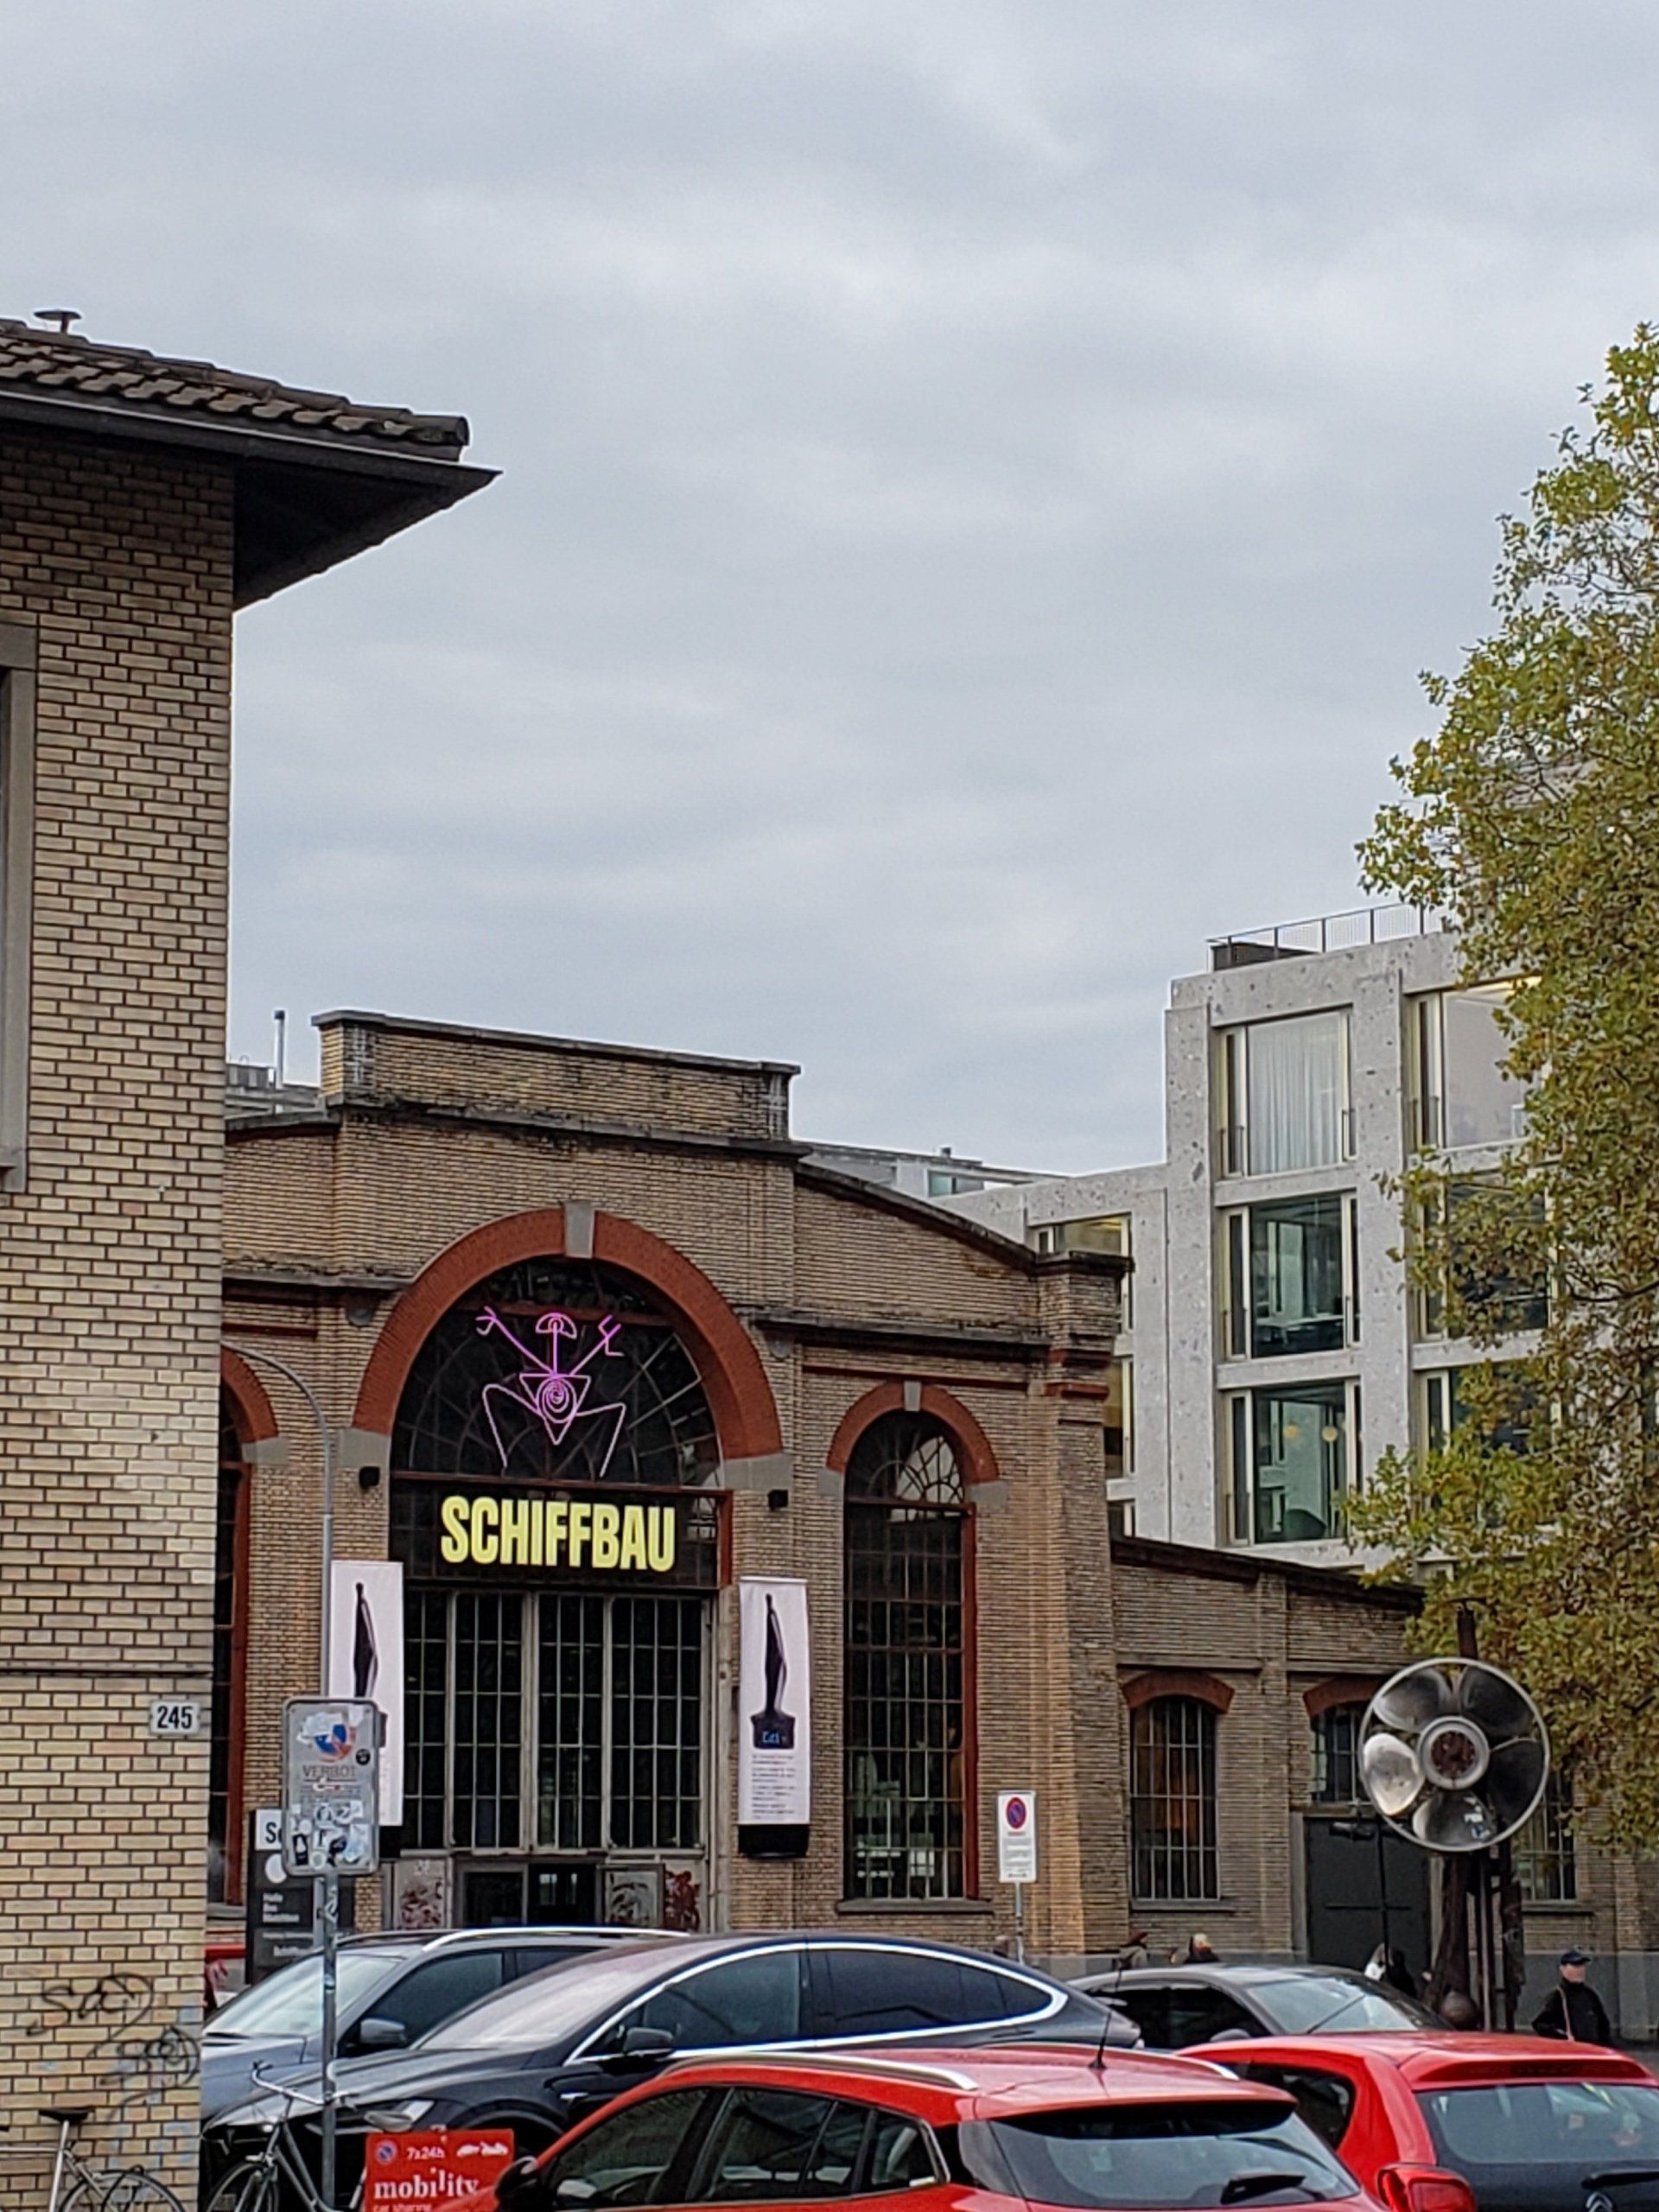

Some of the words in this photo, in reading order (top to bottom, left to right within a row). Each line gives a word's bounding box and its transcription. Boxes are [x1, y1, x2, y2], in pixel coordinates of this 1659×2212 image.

[441, 1496, 676, 1573] SCHIFFBAU
[156, 1705, 194, 1730] 245
[373, 2167, 478, 2200] mobility
